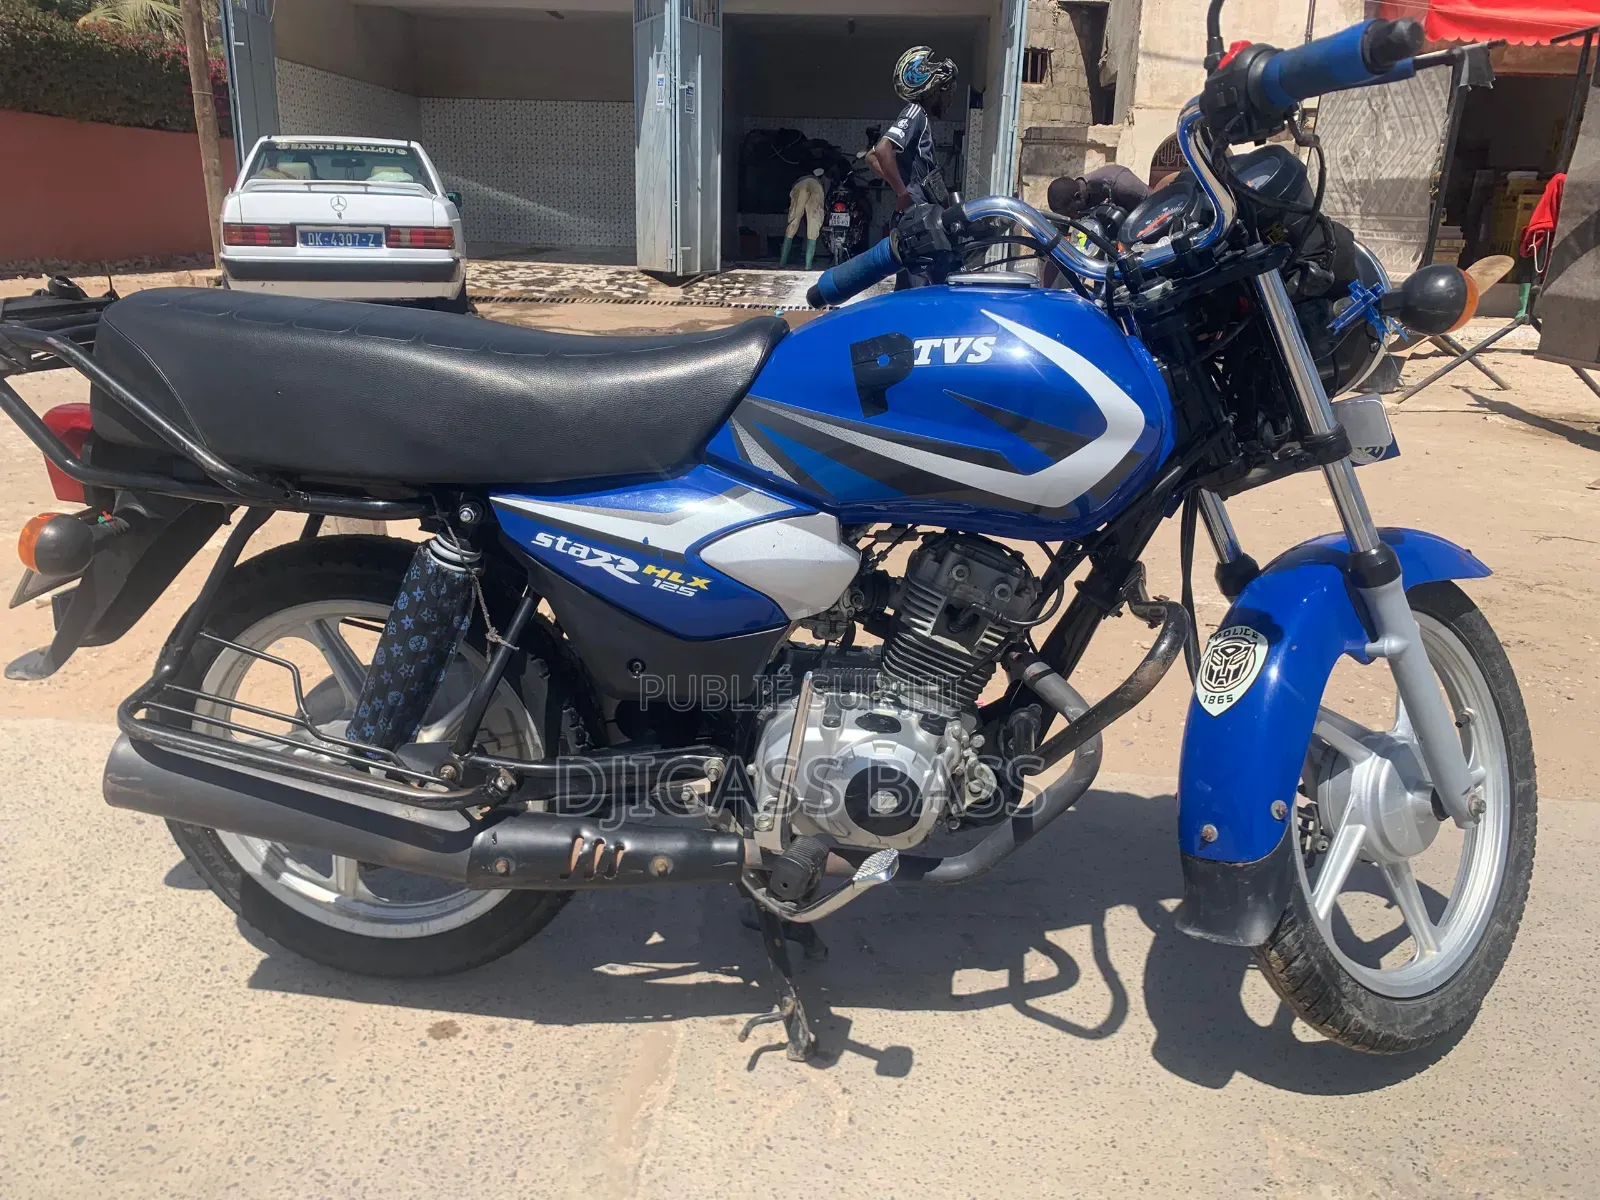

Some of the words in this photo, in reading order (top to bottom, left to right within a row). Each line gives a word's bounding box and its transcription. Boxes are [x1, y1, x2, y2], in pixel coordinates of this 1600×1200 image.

[346, 144, 395, 154] FALLOU
[913, 336, 996, 366] TVS
[642, 564, 713, 590] HLX
[652, 578, 698, 598] 125
[1215, 627, 1259, 641] POLICE
[1203, 694, 1234, 705] 1865
